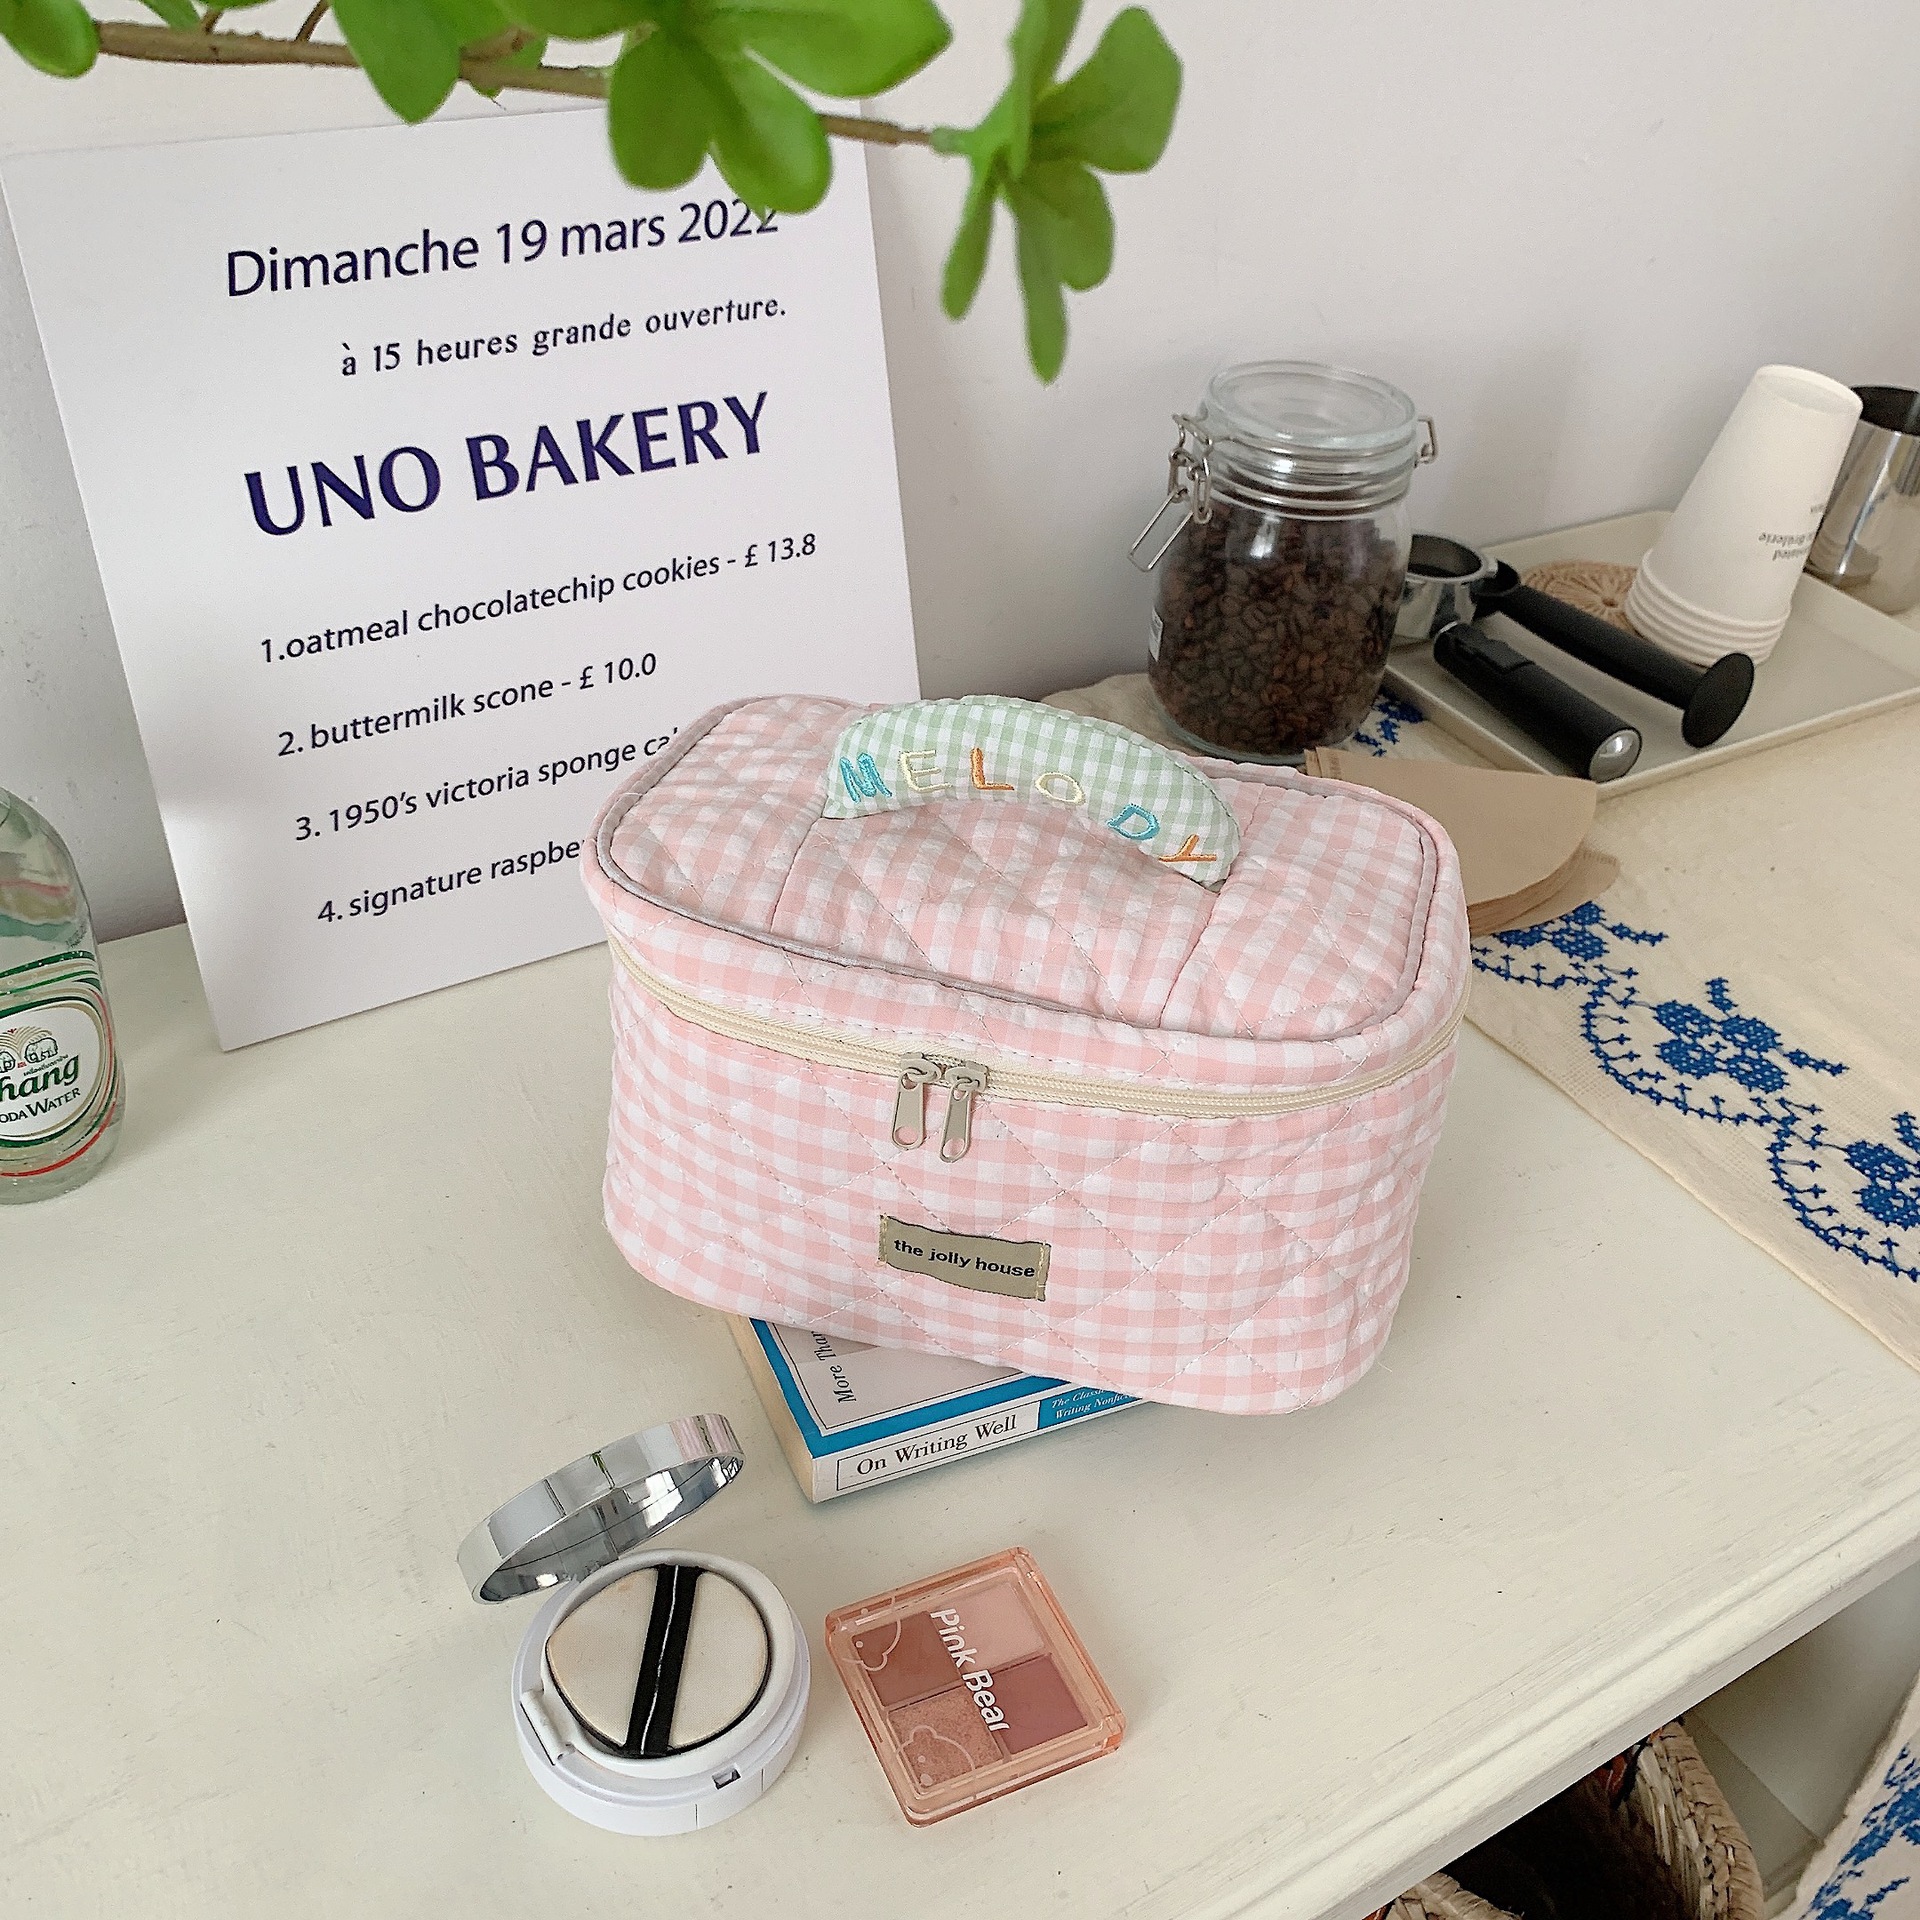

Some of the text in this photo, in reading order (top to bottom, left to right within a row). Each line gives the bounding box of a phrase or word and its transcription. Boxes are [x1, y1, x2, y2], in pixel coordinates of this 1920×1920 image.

[228, 229, 479, 296] Dimanche
[497, 220, 547, 264] 19
[562, 215, 665, 257] mars
[342, 297, 786, 376] à 15 heures grande ouverture.
[244, 391, 767, 536] UNO BAKERY
[261, 610, 407, 662] 1.oatmeal
[418, 574, 614, 631] chocolatechip
[623, 547, 719, 592] cookies
[745, 544, 758, 567] £
[766, 533, 816, 563] 13.8
[278, 732, 303, 756] 2.
[311, 693, 465, 749] buttermilk
[473, 680, 553, 713] scone
[580, 666, 594, 690] £
[605, 653, 656, 683] 10.0
[296, 817, 320, 840] 3.
[329, 792, 417, 831] 1950’s
[426, 767, 529, 808] victoria
[538, 744, 636, 789] sponge
[840, 747, 1217, 862] MELODY
[318, 840, 584, 922] 4. signature raspbe
[0, 1055, 79, 1102] hang
[0, 1088, 81, 1123] ODA WATER
[894, 1239, 1035, 1277] the jolly house
[830, 1365, 857, 1403] More
[1052, 1398, 1070, 1409] The
[1056, 1403, 1092, 1419] Writing
[857, 1415, 1016, 1475] On Writing Well
[930, 1608, 1010, 1732] Pink Bear
